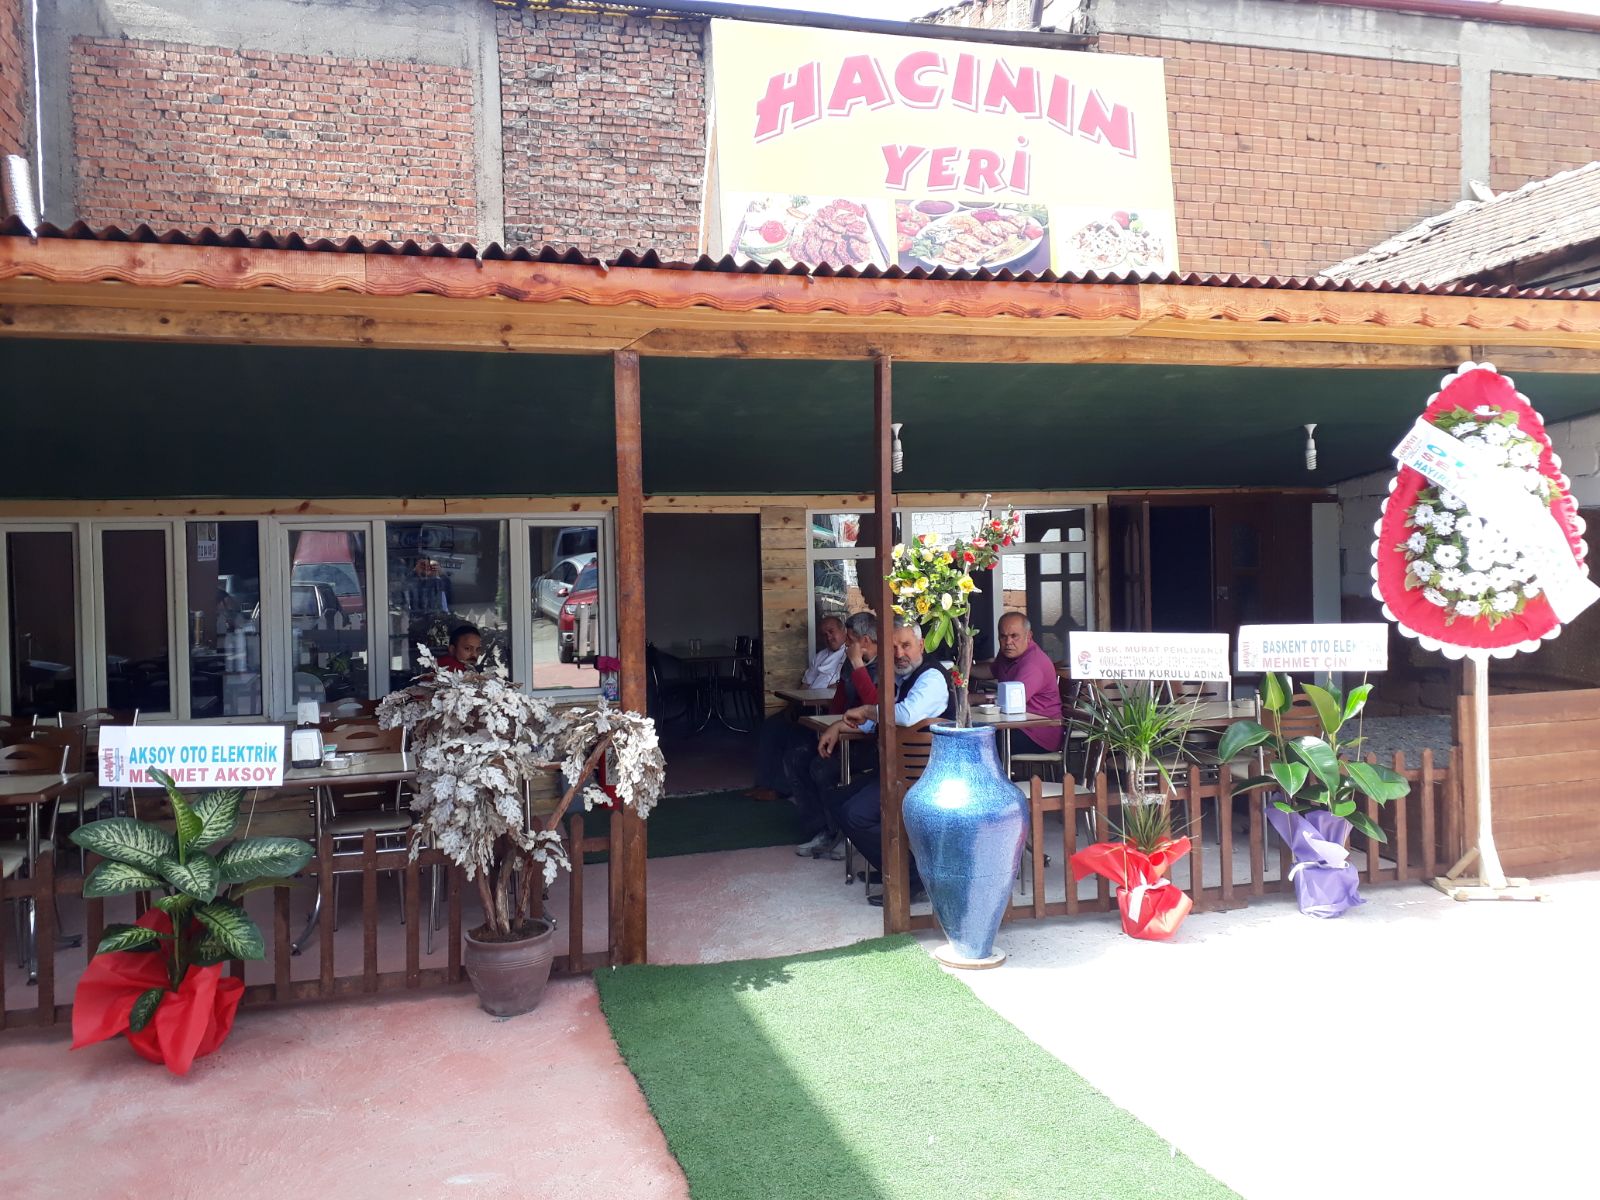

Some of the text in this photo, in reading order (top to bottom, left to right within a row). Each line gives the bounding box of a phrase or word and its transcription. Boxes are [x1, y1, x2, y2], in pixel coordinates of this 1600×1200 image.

[754, 51, 1137, 158] HACININ
[881, 135, 1030, 195] YERİ
[1125, 646, 1161, 654] MURAT
[1310, 640, 1330, 653] OTO
[1262, 657, 1319, 669] MEHMET
[1149, 669, 1190, 679] KURULU
[1194, 670, 1224, 680] ADINA
[129, 742, 278, 764] AKSOY OTO ELEKTRİK
[214, 767, 277, 782] AKSOY
